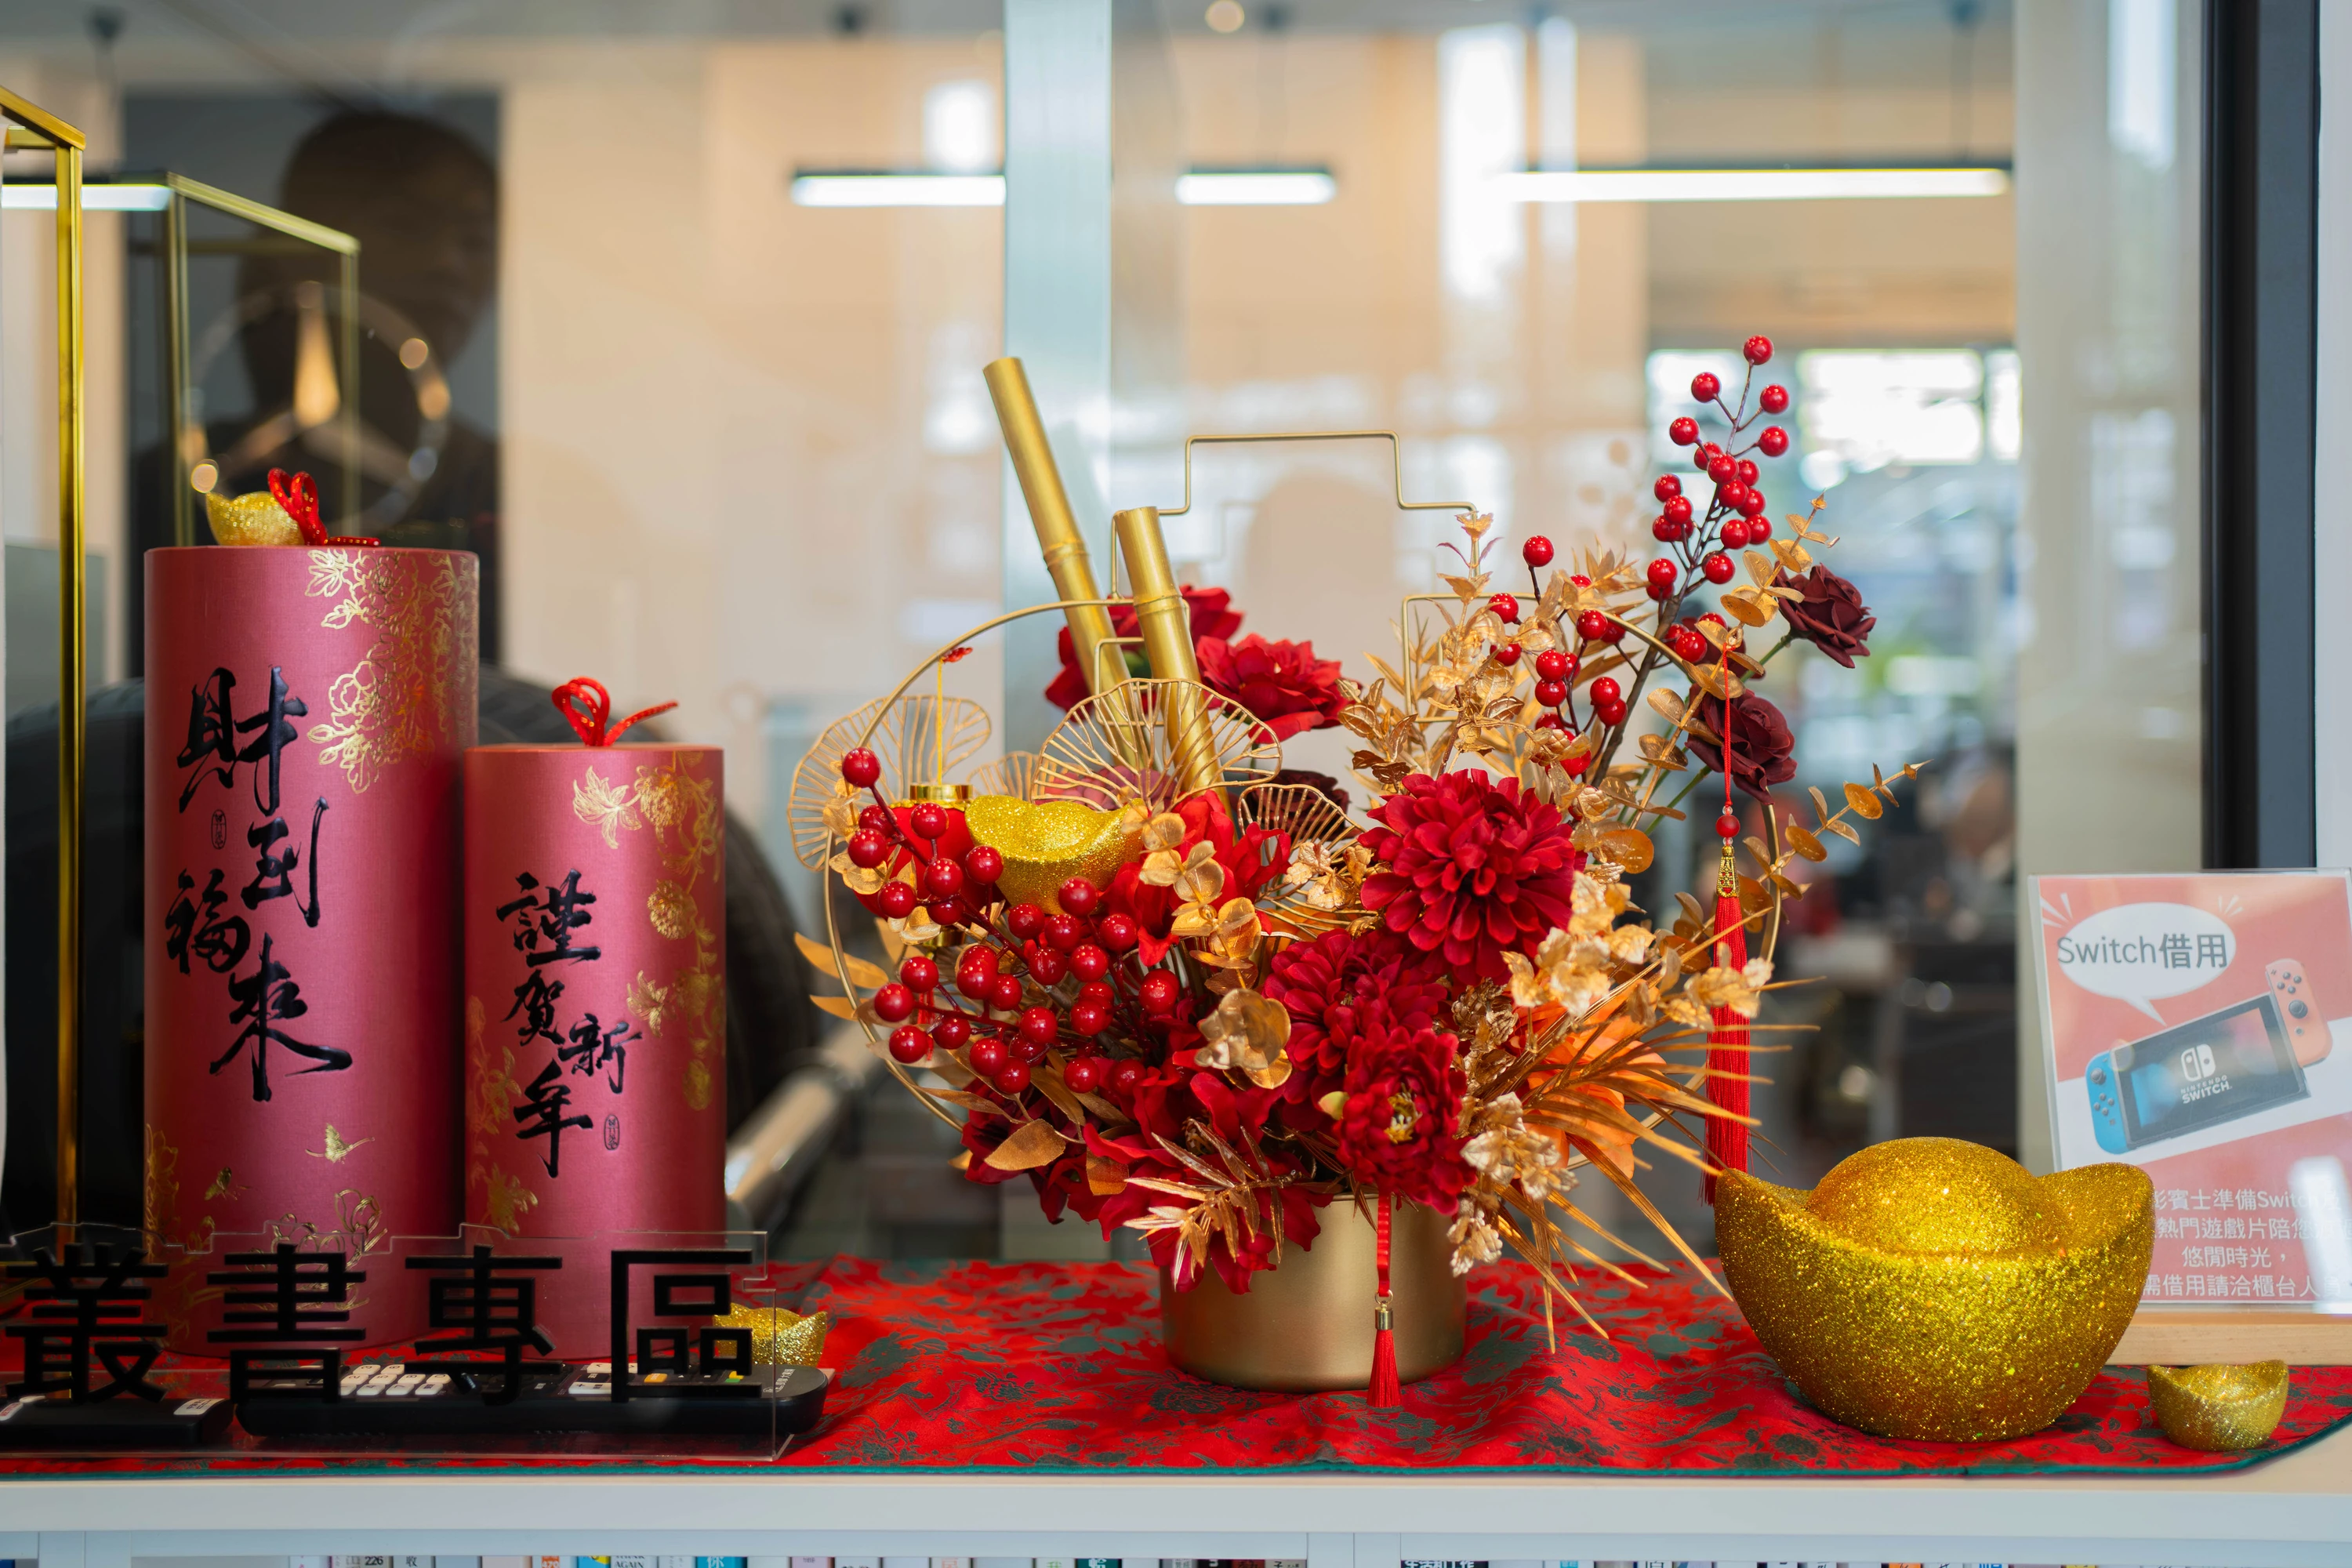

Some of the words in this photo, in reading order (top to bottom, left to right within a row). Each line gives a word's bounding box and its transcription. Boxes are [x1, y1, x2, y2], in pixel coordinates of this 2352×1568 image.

[2056, 933, 2228, 970] Switch借用
[496, 869, 642, 1178] 謹賀新年
[2180, 1074, 2227, 1094] NINTENDO
[2182, 1080, 2230, 1104] SWITCH
[5, 1243, 761, 1406] 叢書專區
[365, 1556, 383, 1566] 226
